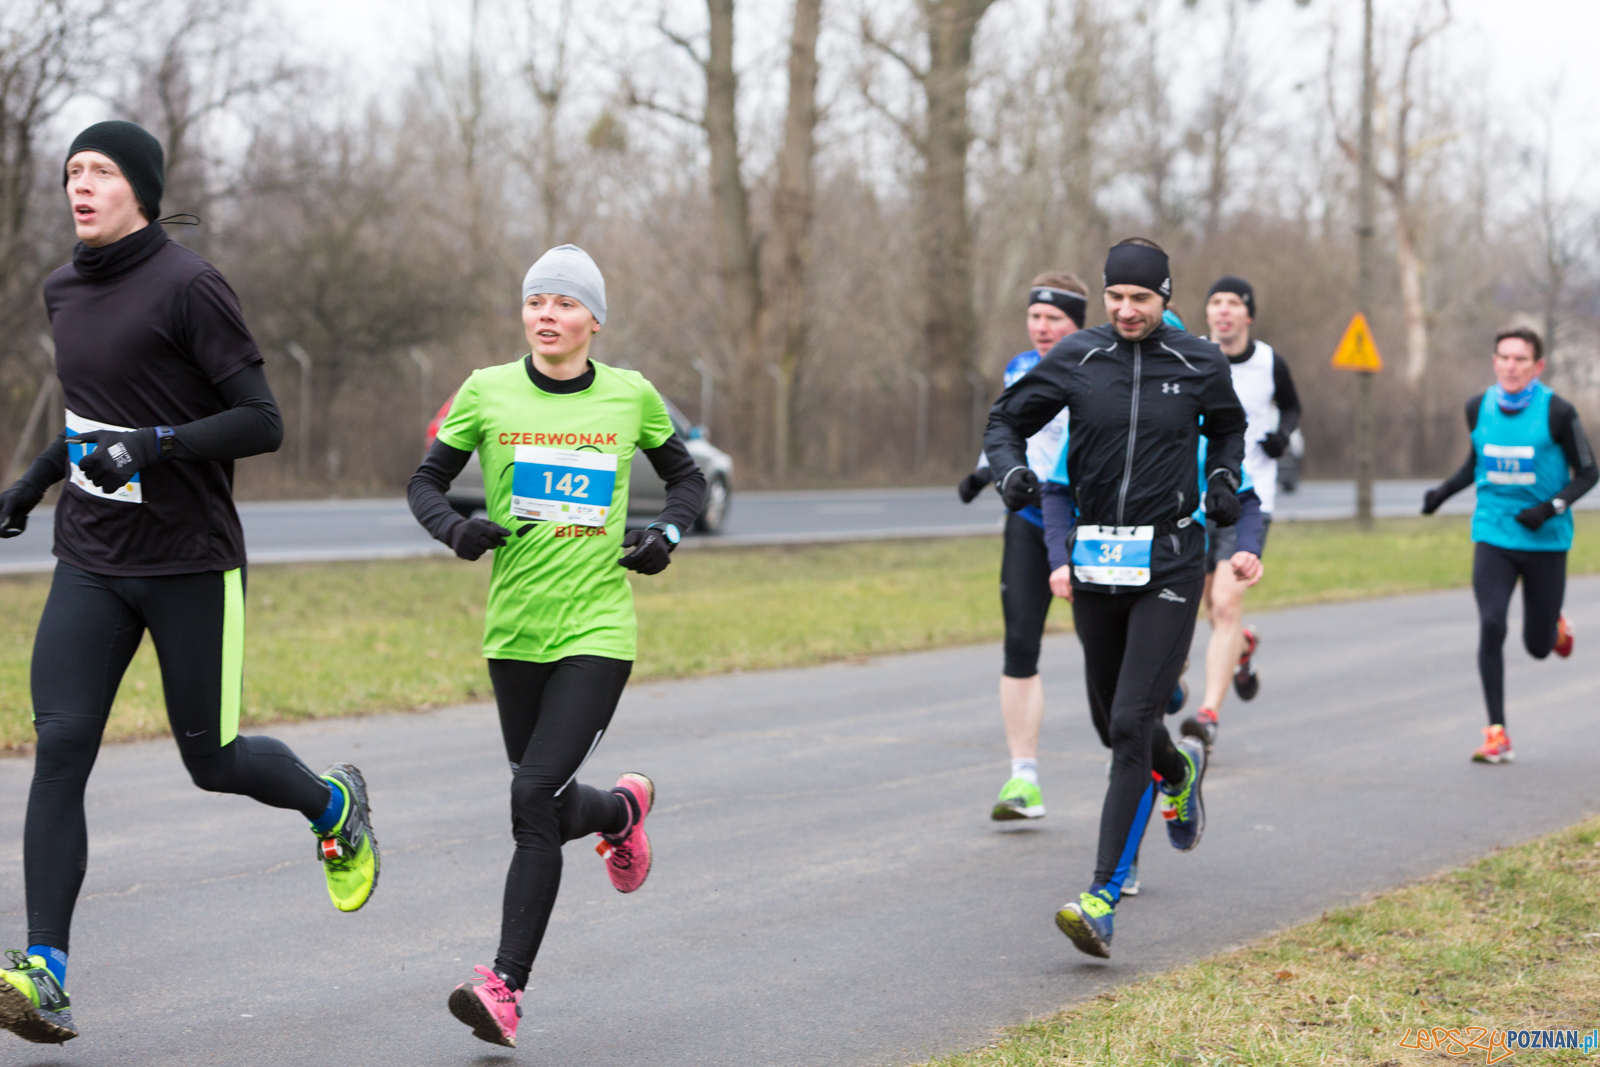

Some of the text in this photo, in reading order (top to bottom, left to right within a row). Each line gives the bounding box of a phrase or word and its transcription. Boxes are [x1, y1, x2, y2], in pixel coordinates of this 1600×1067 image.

[498, 432, 618, 446] CZERWONAK
[542, 471, 590, 498] 142
[554, 525, 607, 538] BIEGA
[1098, 543, 1123, 563] 34
